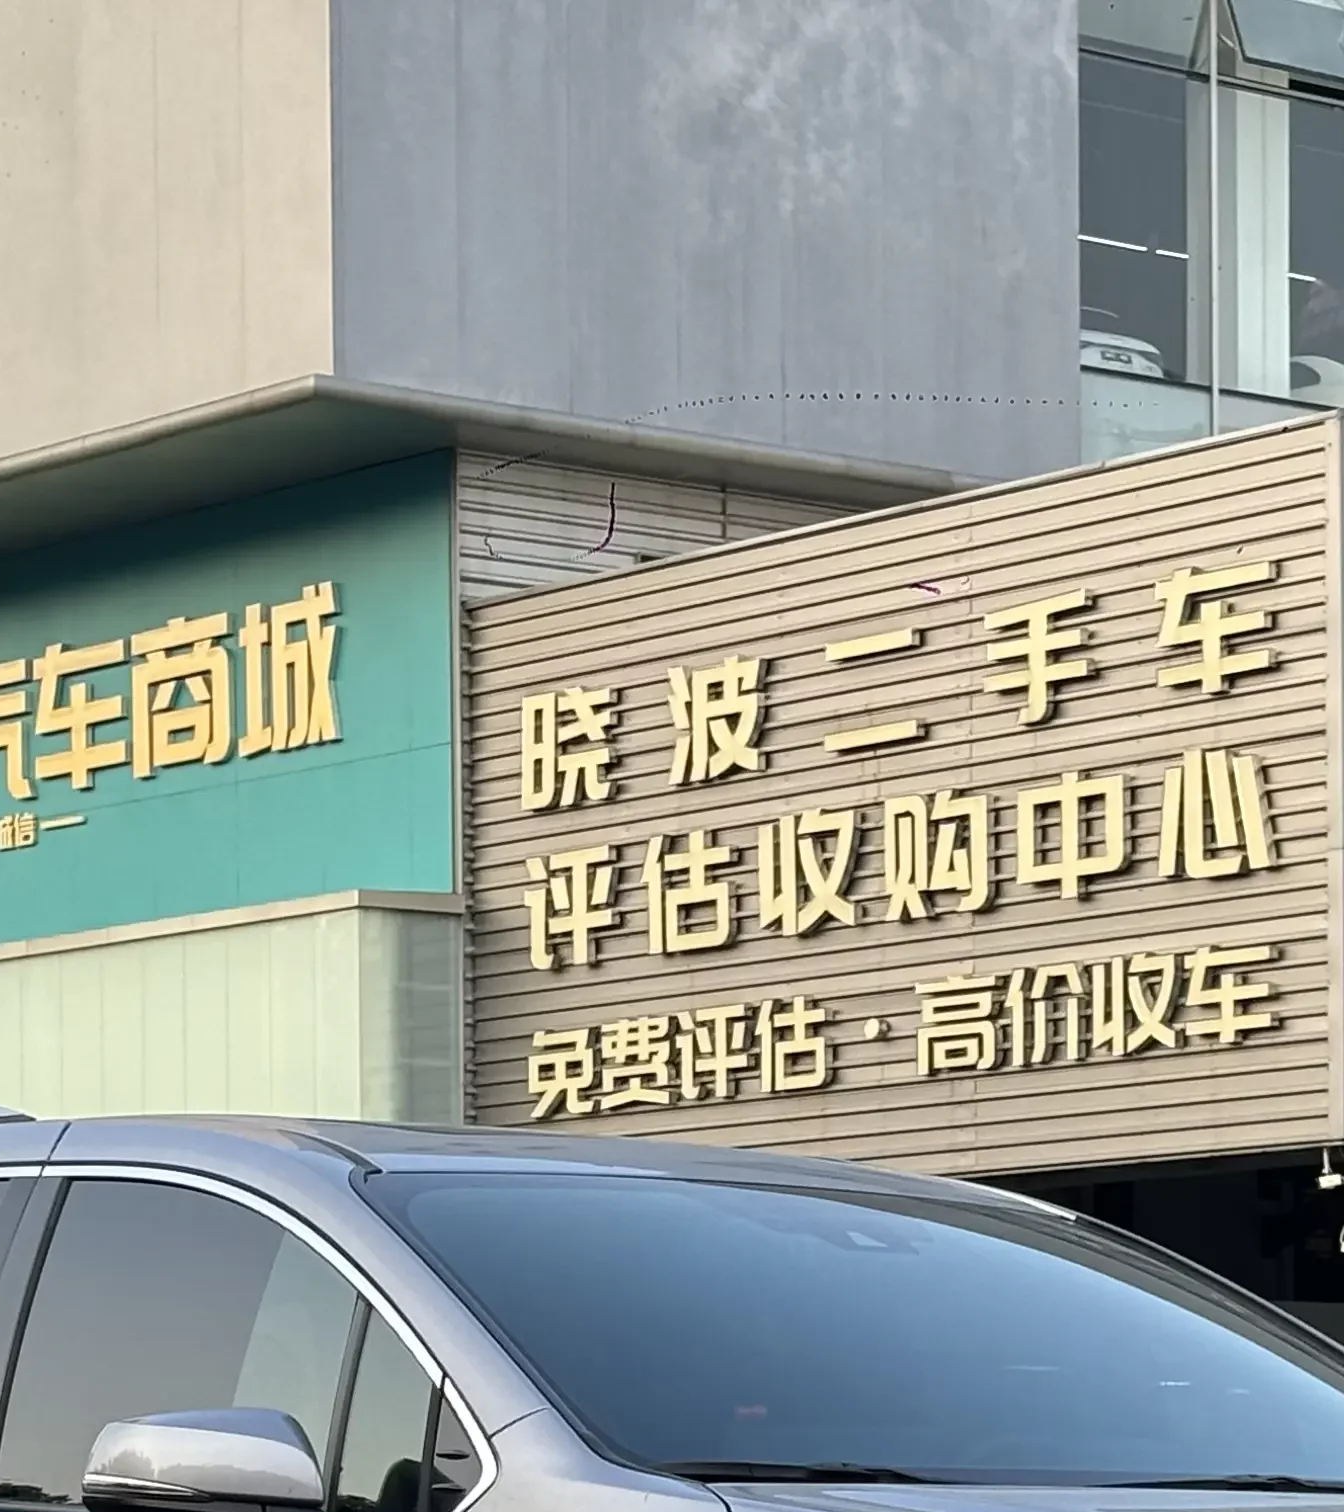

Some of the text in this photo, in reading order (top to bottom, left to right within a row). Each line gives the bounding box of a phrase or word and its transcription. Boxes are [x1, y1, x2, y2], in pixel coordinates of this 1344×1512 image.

[520, 560, 1279, 812] 晓波二手车
[523, 748, 1278, 972] 评估收购中心
